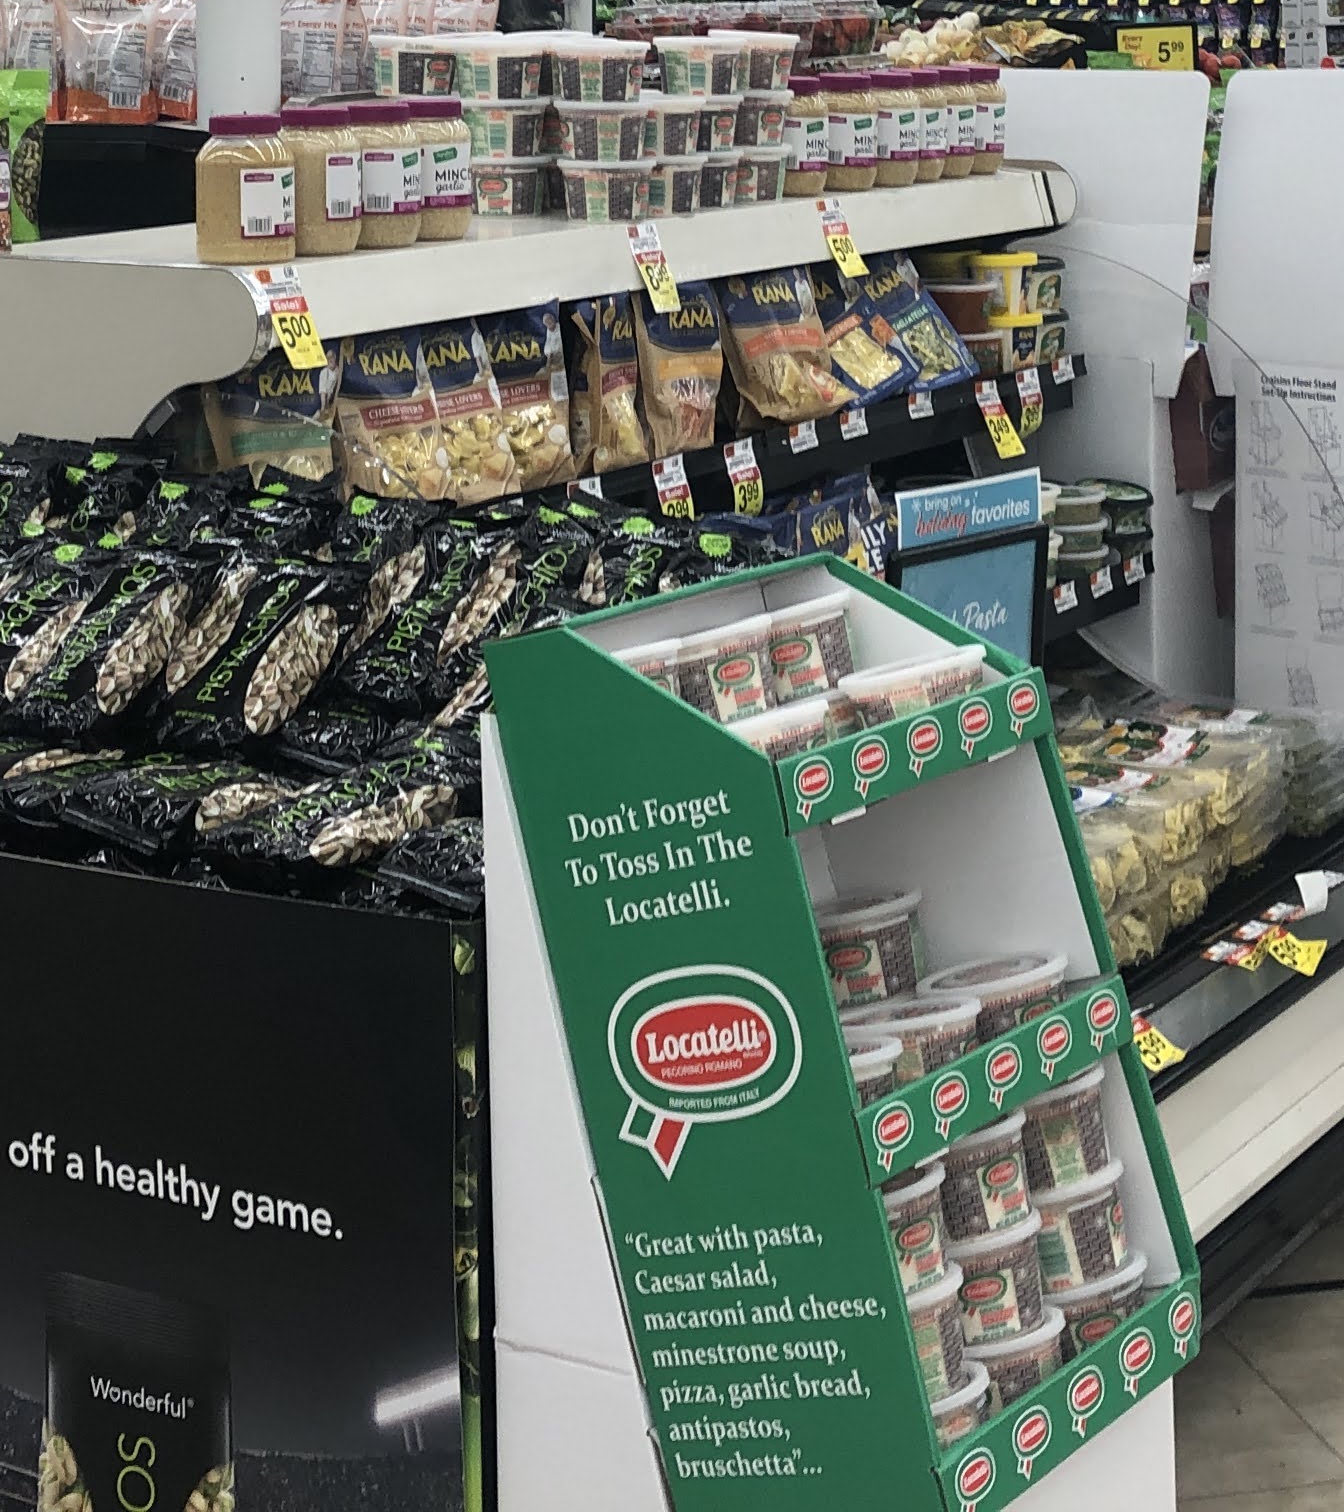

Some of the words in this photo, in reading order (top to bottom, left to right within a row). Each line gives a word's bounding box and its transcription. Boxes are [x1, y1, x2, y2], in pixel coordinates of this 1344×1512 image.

[752, 283, 796, 306] RANA
[864, 268, 904, 302] RANA
[669, 306, 715, 330] RANA
[358, 349, 414, 376] RANA
[426, 339, 471, 369] ANA
[511, 383, 541, 397] LOVERS
[924, 495, 949, 512] bring
[971, 498, 1031, 526] favorites
[812, 518, 845, 549] RANA
[962, 600, 1009, 632] Pasta
[568, 804, 643, 844] Don't
[644, 789, 731, 832] Forget
[565, 857, 597, 888] To
[599, 846, 660, 884] Toss
[665, 840, 696, 872] In
[697, 831, 754, 866] The
[604, 880, 731, 927] Locatelli.
[644, 1018, 762, 1065] Locatelli
[661, 1064, 704, 1079] PECORINO
[705, 1058, 743, 1073] ROMANO
[668, 1096, 713, 1110] IMPORTED
[713, 1092, 738, 1108] FROM
[739, 1088, 760, 1104] ITALY
[8, 1129, 56, 1174] off
[65, 1149, 85, 1181] a
[94, 1144, 221, 1221] healthy
[230, 1187, 345, 1241] game.
[697, 1221, 750, 1255] with
[754, 1220, 824, 1253] pasta,
[635, 1265, 709, 1297] Caesar
[712, 1259, 778, 1292] salad,
[644, 1301, 747, 1334] macaroni
[750, 1296, 795, 1326] and
[798, 1292, 887, 1323] cheese,
[652, 1339, 779, 1371] minestrone
[783, 1338, 847, 1367] soup,
[89, 1375, 187, 1421] Wonderful
[659, 1379, 724, 1412] pizza,
[727, 1373, 793, 1409] garlic
[796, 1371, 871, 1403] bread,
[668, 1413, 791, 1445] antipastos,
